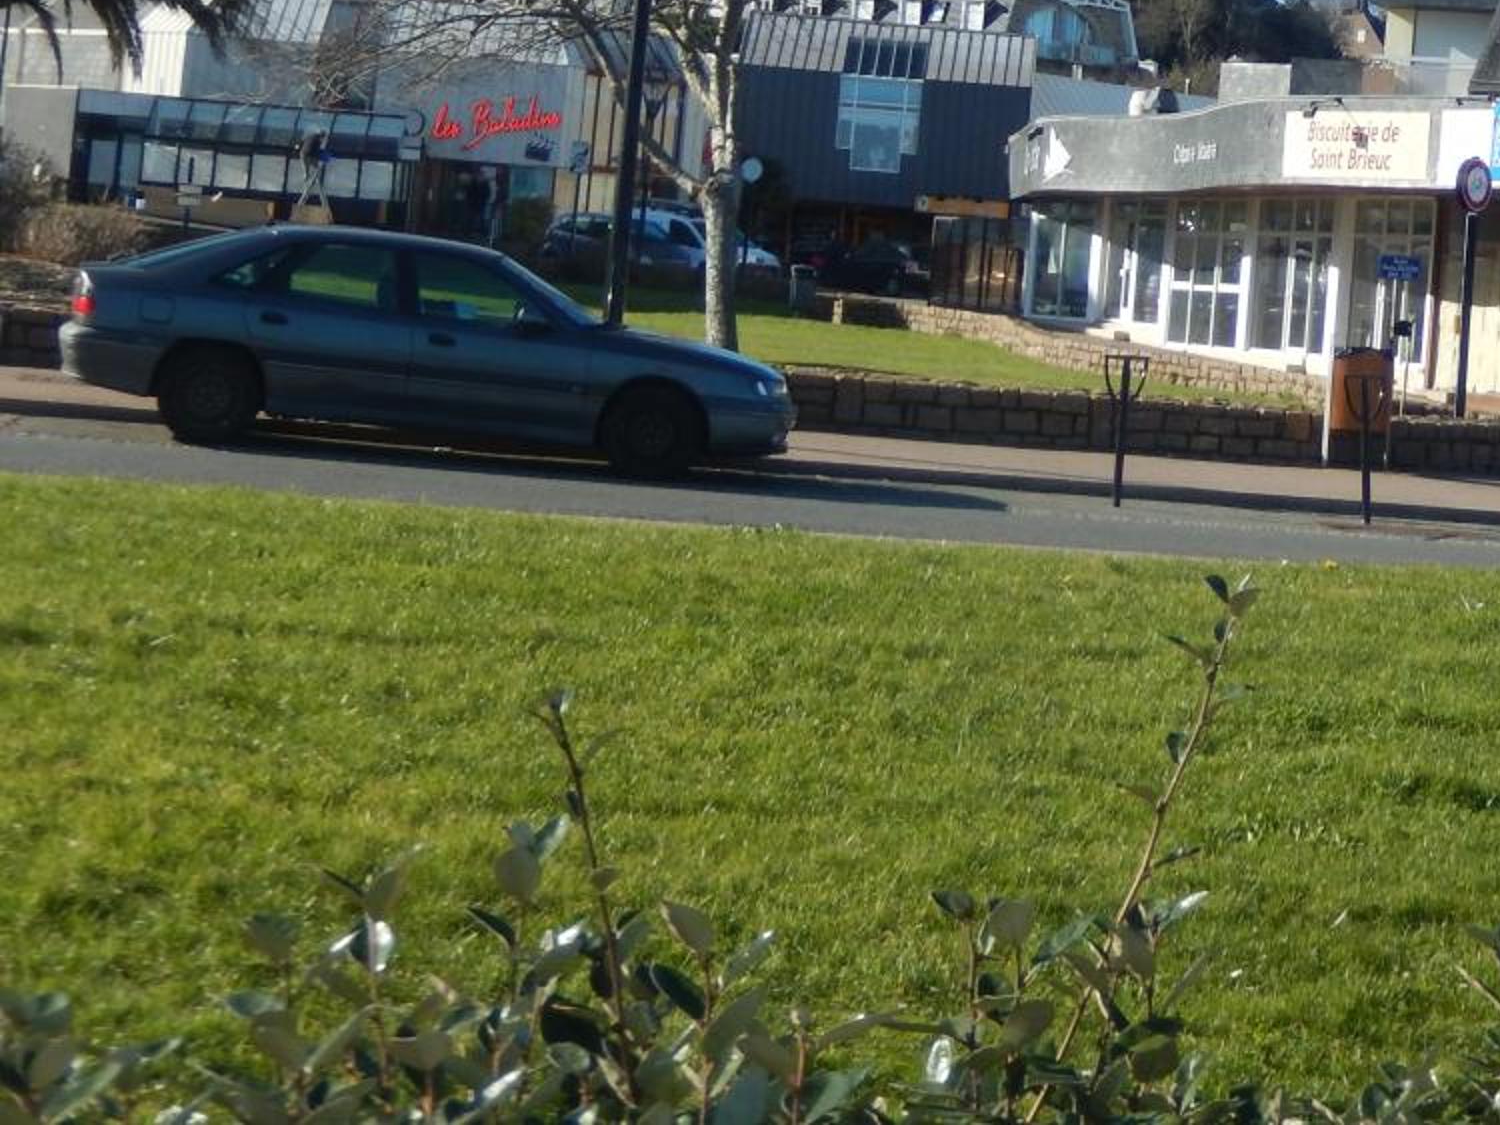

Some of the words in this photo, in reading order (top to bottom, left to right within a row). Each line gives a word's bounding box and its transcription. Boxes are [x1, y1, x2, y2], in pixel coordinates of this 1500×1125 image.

[1381, 120, 1400, 143] de
[1310, 147, 1343, 170] Saint
[1347, 147, 1393, 171] Brieuc
